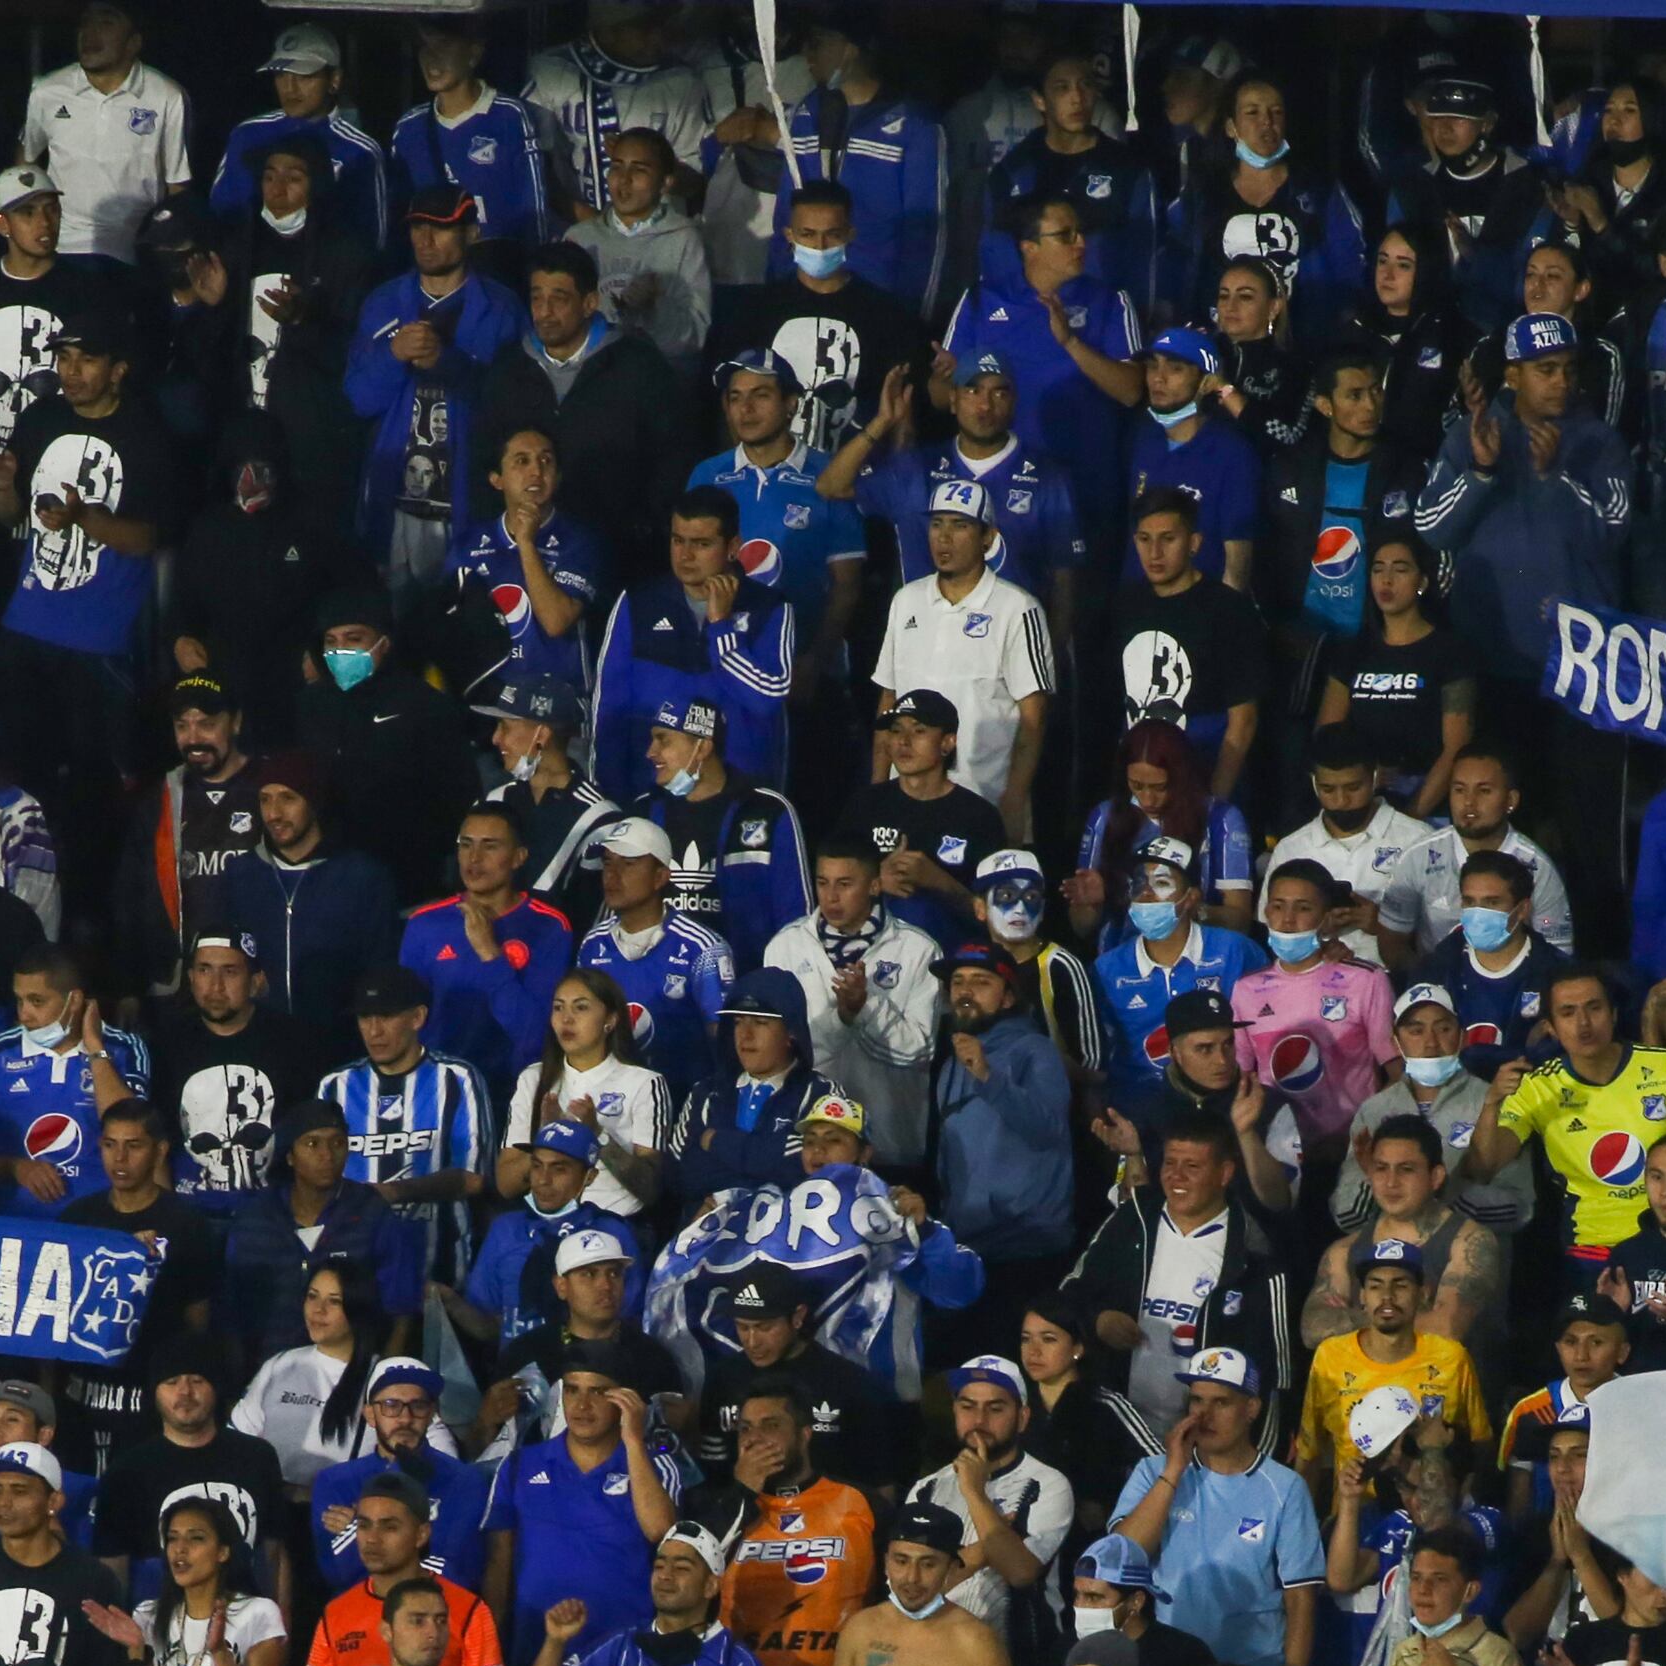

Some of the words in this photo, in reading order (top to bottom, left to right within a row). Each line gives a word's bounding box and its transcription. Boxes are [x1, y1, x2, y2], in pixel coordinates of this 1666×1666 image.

[1535, 333, 1565, 351] AZUL
[944, 483, 974, 506] 74
[1319, 582, 1355, 601] epsi
[347, 1128, 441, 1158] PEPSI
[734, 1298, 765, 1307] adidas
[735, 1537, 845, 1563] PEPSI
